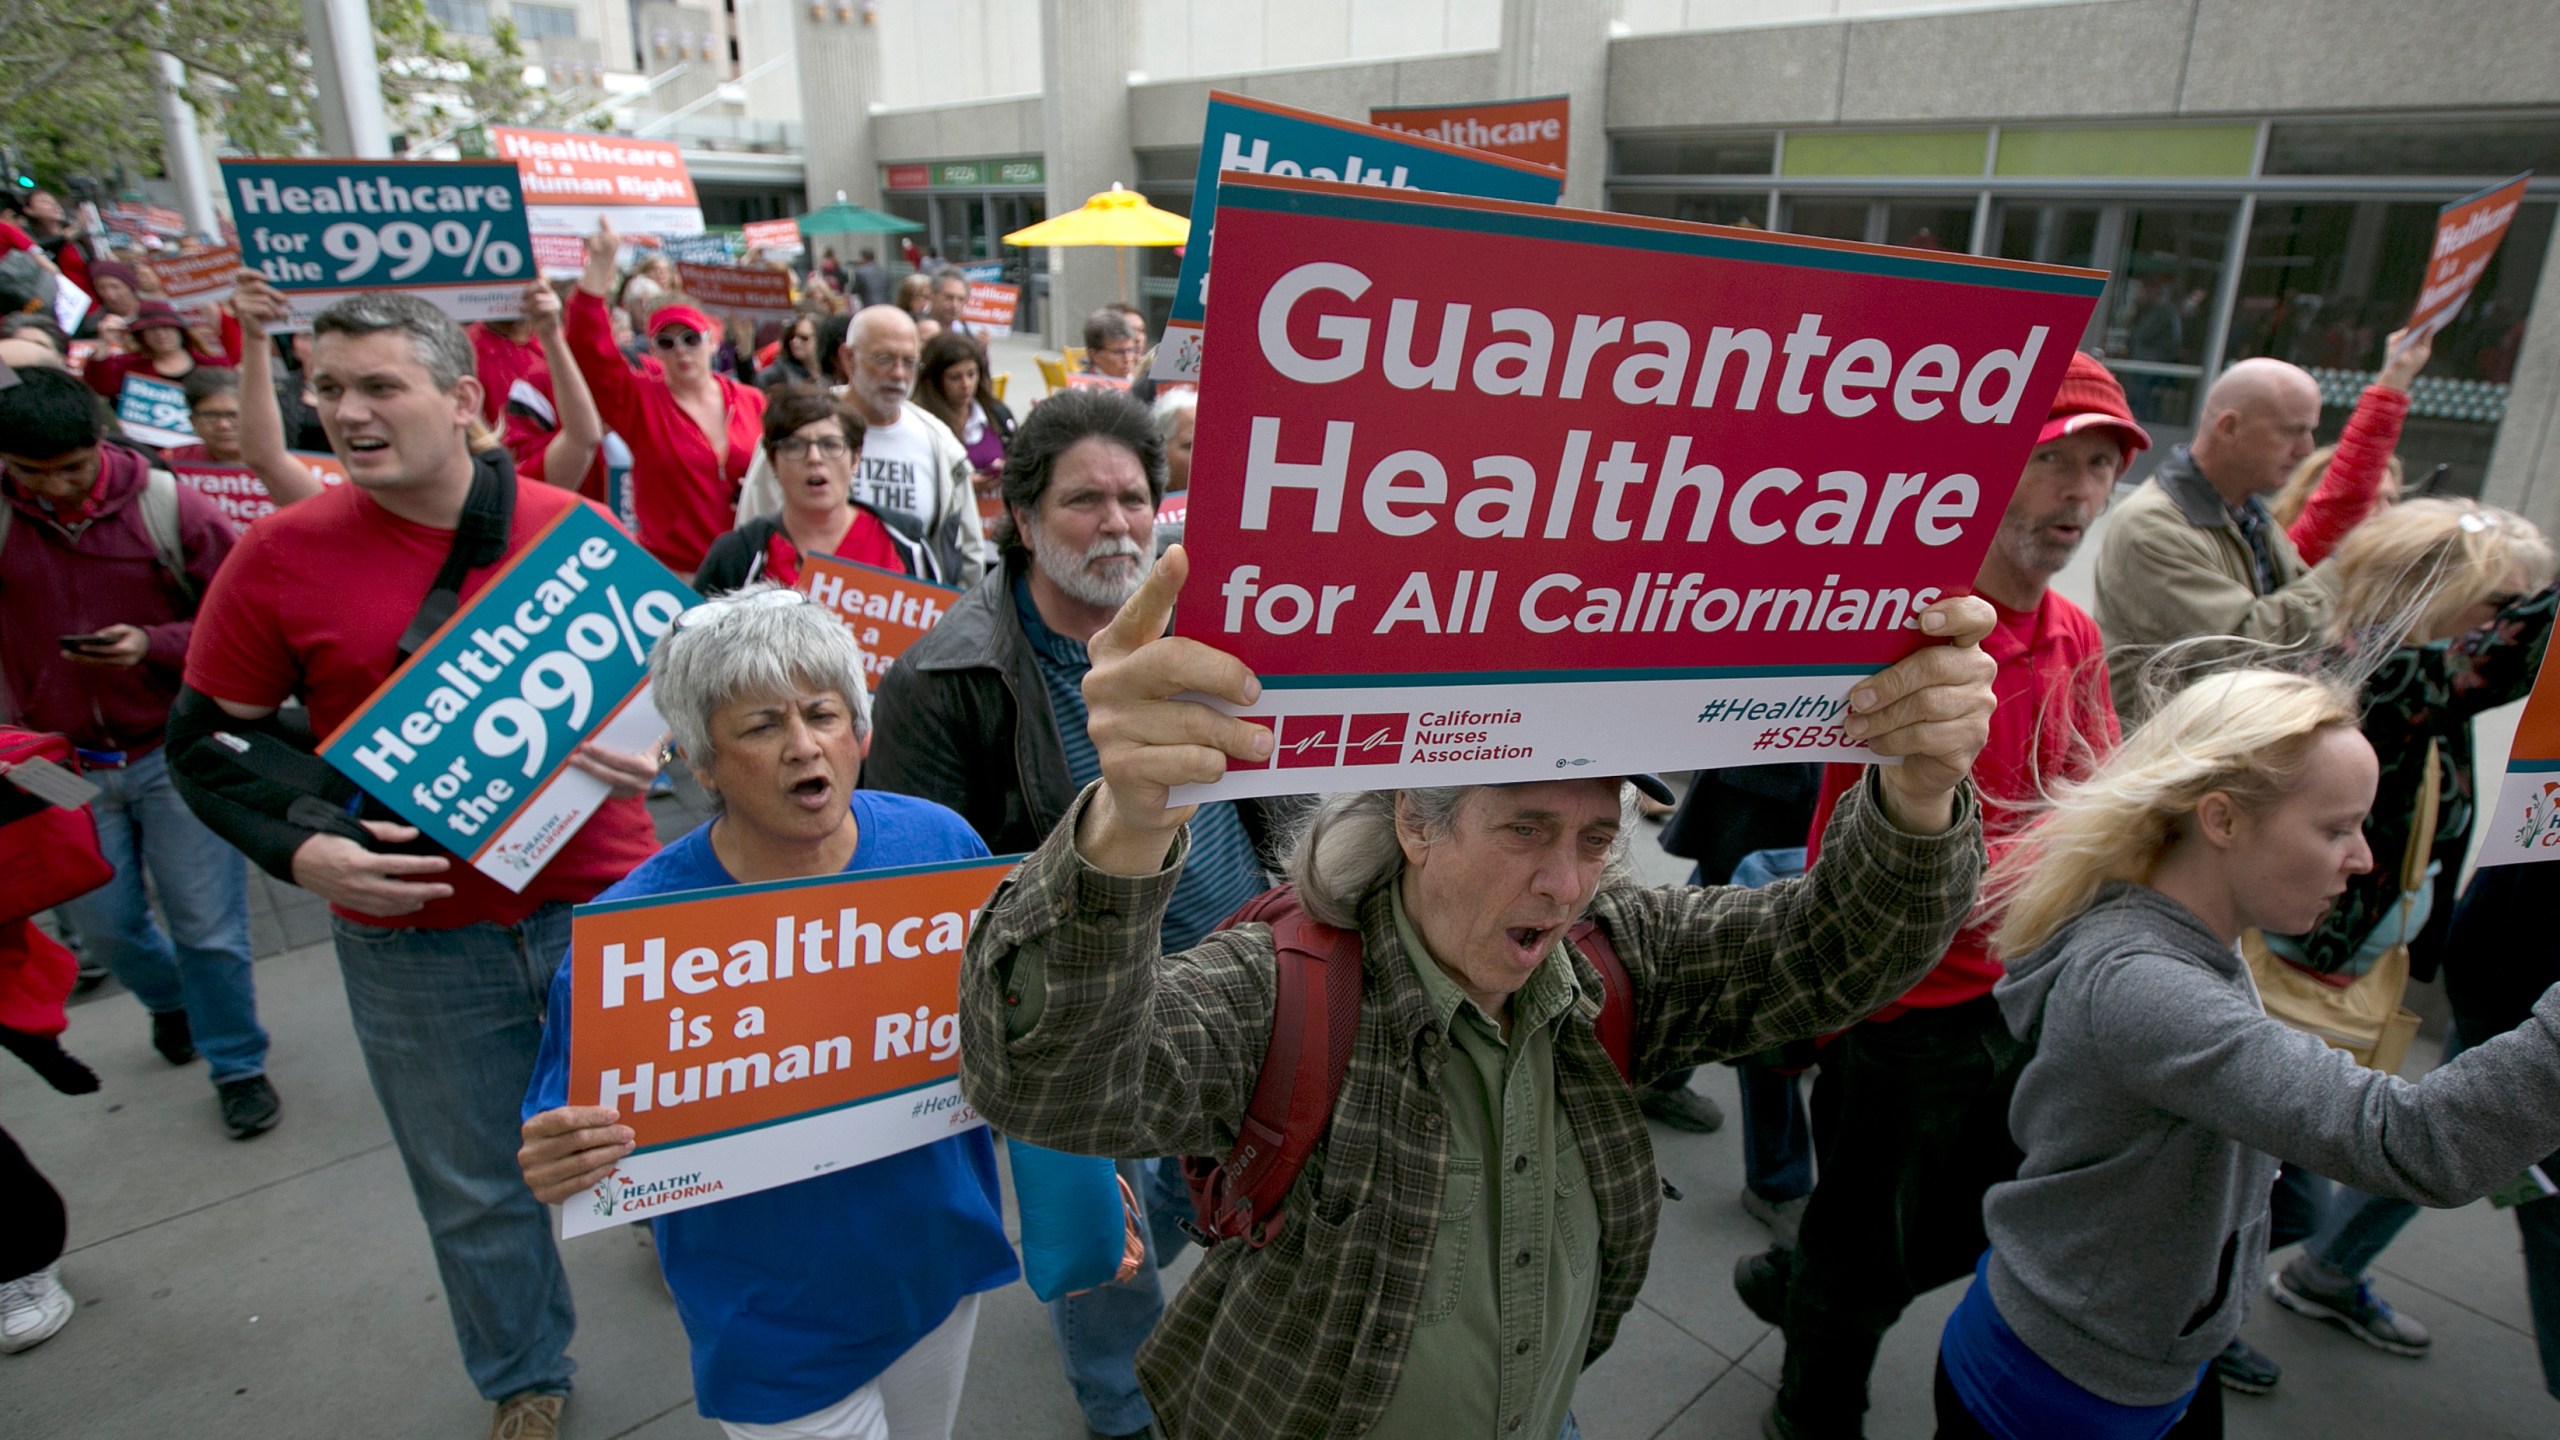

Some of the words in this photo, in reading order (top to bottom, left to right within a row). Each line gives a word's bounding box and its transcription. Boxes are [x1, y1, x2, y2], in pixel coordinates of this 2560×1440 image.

[504, 133, 676, 168] Healthcare
[559, 162, 574, 175] a
[238, 176, 513, 214] Healthcare
[521, 172, 613, 194] Human
[616, 175, 686, 201] Right
[254, 227, 310, 253] for
[321, 220, 524, 282] 99%
[260, 256, 323, 282] the
[1258, 261, 2050, 424] Guaranteed
[871, 484, 916, 509] THE
[1240, 415, 1980, 546] Healthcare
[1222, 565, 1356, 635] for
[1373, 570, 1498, 634] All
[1519, 572, 1942, 633] Californians
[353, 536, 617, 783] Healthcare
[473, 584, 684, 779] 99%
[1419, 709, 1522, 727] California
[1698, 694, 1853, 722] #Healthy
[1410, 745, 1533, 764] Association
[1414, 728, 1487, 746] Nurses
[412, 755, 473, 814] for
[448, 777, 514, 837] the
[522, 814, 560, 855] HEALTHY
[530, 808, 580, 860] CALIFORNIA
[602, 907, 978, 1009] Healthca
[669, 1007, 714, 1052] is
[733, 1006, 765, 1038] a
[599, 1035, 852, 1114] Human
[622, 1180, 724, 1212] CALIFORNIA
[623, 1172, 702, 1199] HEALTHY
